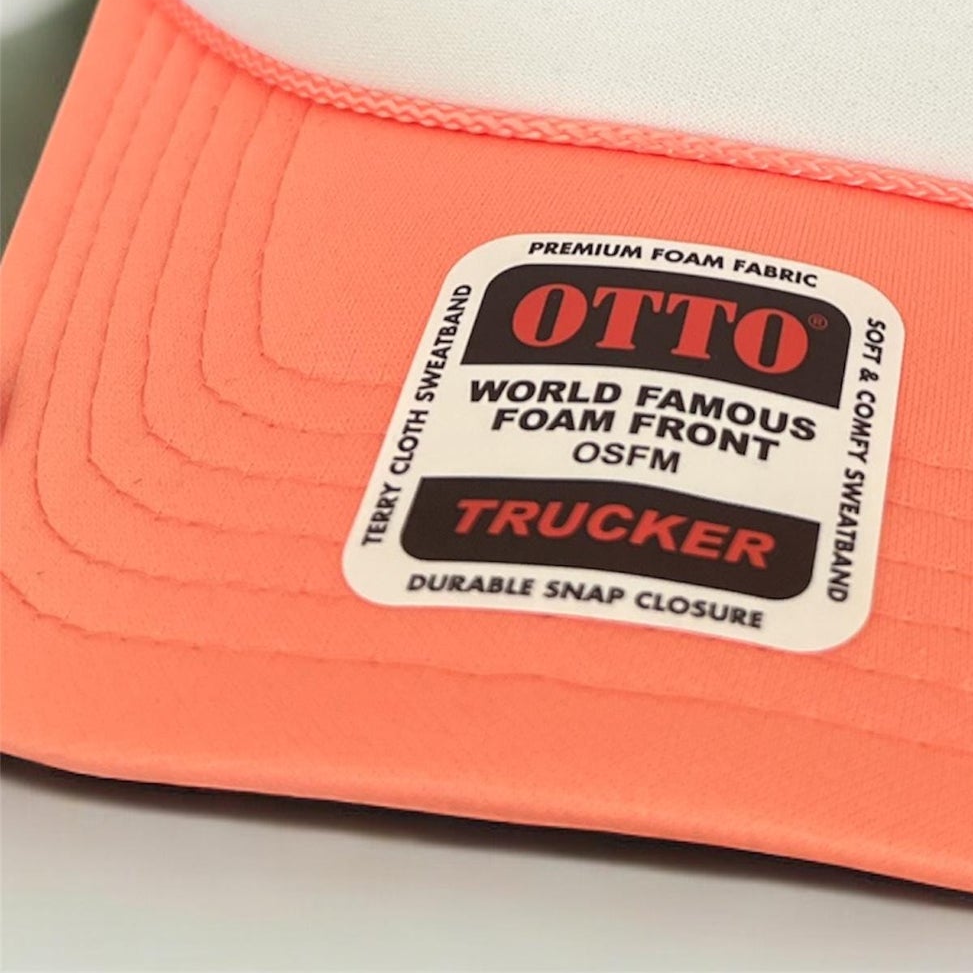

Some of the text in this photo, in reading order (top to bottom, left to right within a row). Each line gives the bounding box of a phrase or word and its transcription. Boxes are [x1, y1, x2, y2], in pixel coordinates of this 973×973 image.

[528, 241, 819, 288] PREMIUM FOAM FABRIC
[361, 284, 472, 546] TERRY CLOTH SWEATBAND
[470, 380, 817, 440] WORLD FAMOUS
[491, 409, 780, 461] FOAM FRONT
[573, 442, 681, 473] OSFM
[827, 317, 886, 602] SOFT & COMFY SWEATBAND
[455, 498, 777, 569] TRUCKER
[406, 574, 764, 629] DURABLE SNAP CLOSURE
